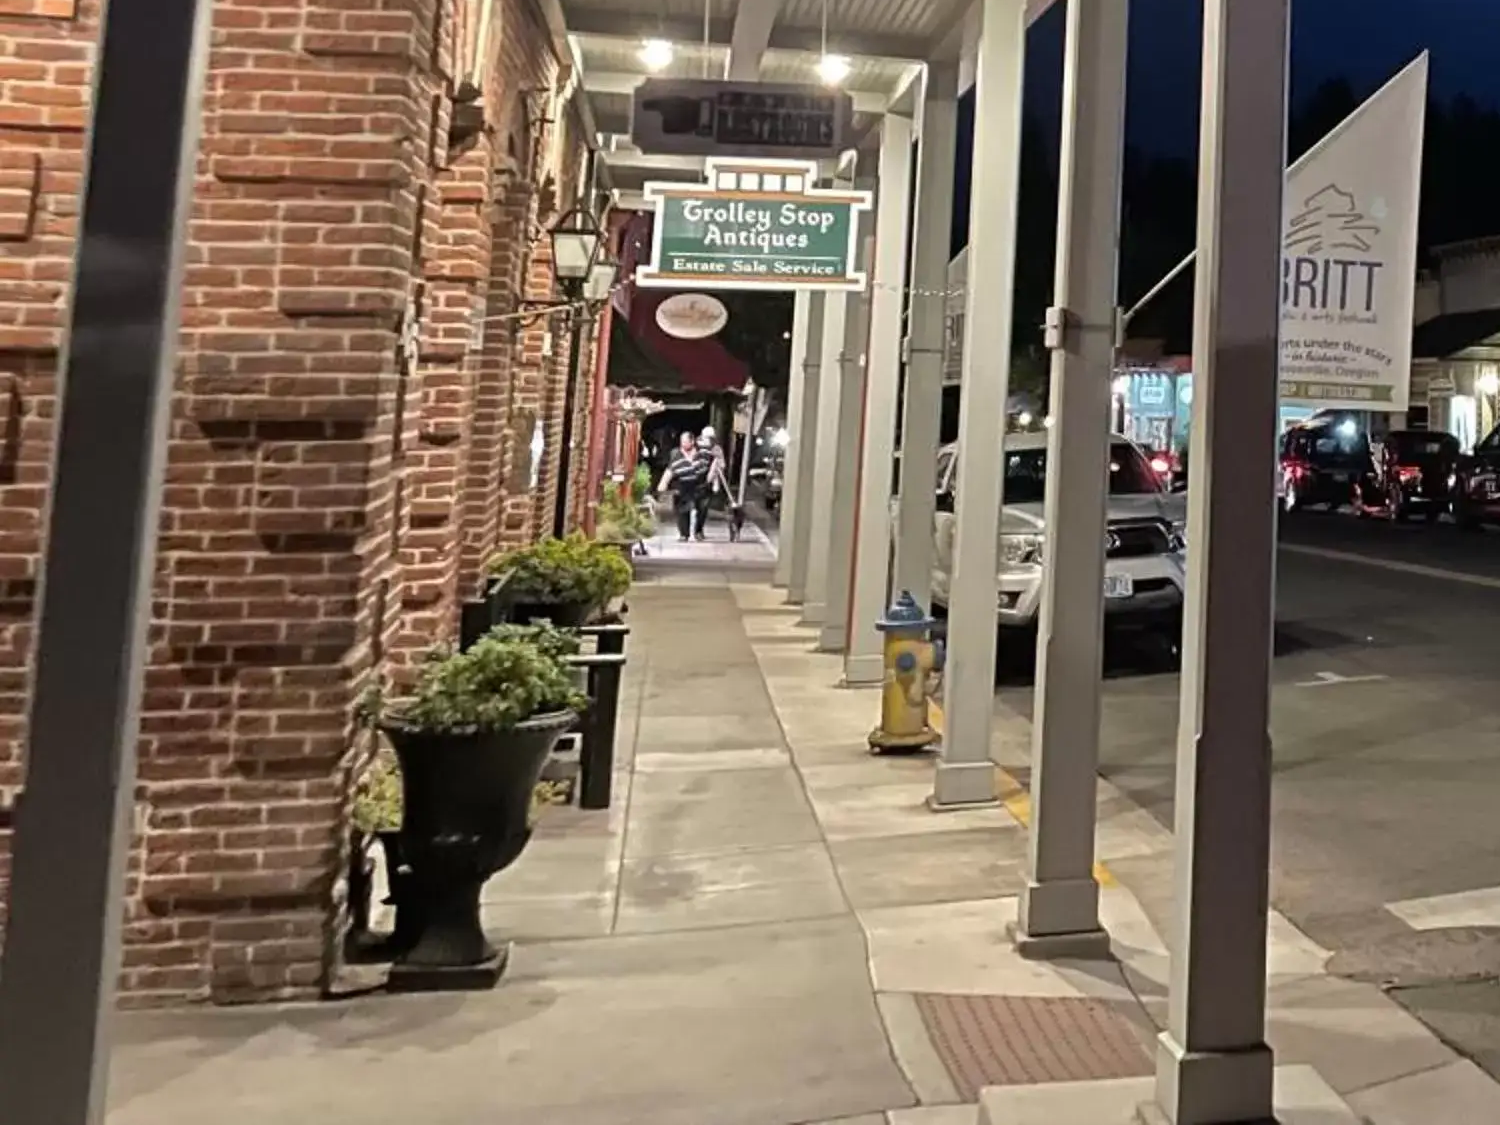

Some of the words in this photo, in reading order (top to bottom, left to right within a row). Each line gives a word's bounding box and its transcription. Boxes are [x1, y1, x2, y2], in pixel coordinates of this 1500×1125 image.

[681, 199, 771, 231] Trolley
[779, 203, 835, 234] Stop
[704, 224, 808, 253] Antiques
[673, 259, 726, 272] Estate
[732, 260, 767, 273] Sale
[774, 261, 834, 275] Service
[1304, 339, 1339, 349] under
[1343, 341, 1362, 353] the
[1365, 347, 1392, 366] stars
